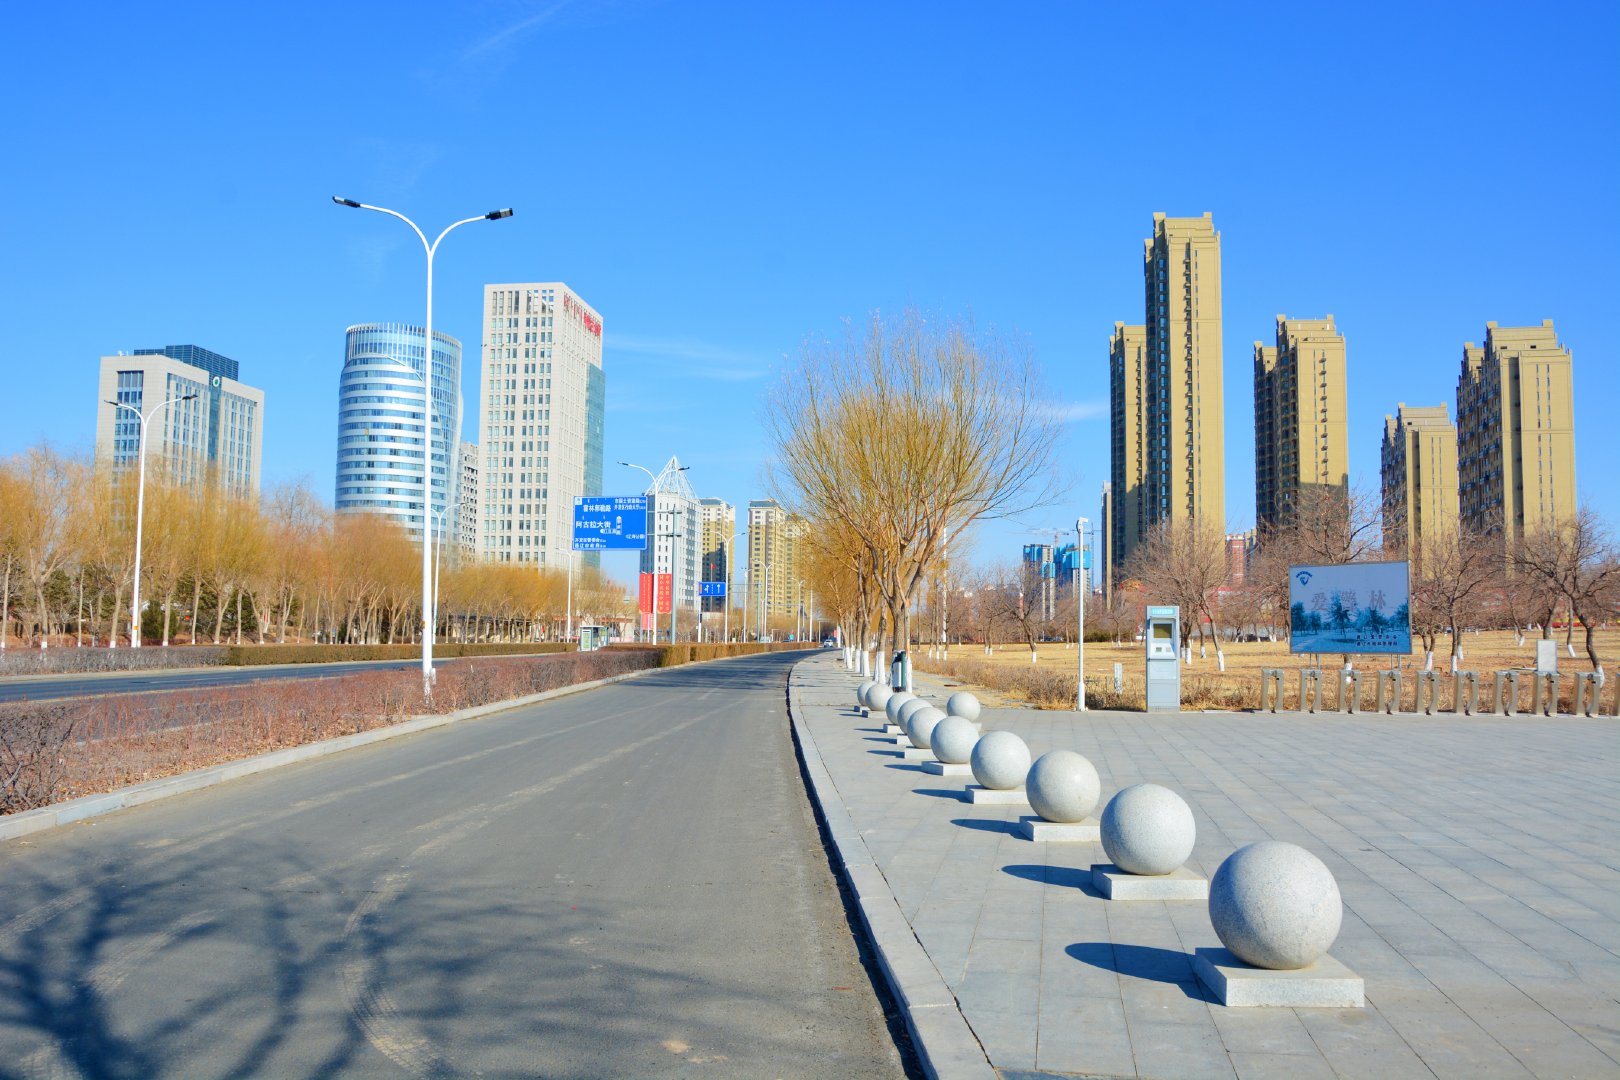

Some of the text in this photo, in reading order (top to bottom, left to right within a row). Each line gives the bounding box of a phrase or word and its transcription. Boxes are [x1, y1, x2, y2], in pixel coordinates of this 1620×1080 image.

[576, 520, 611, 529] 阿古拉大街
